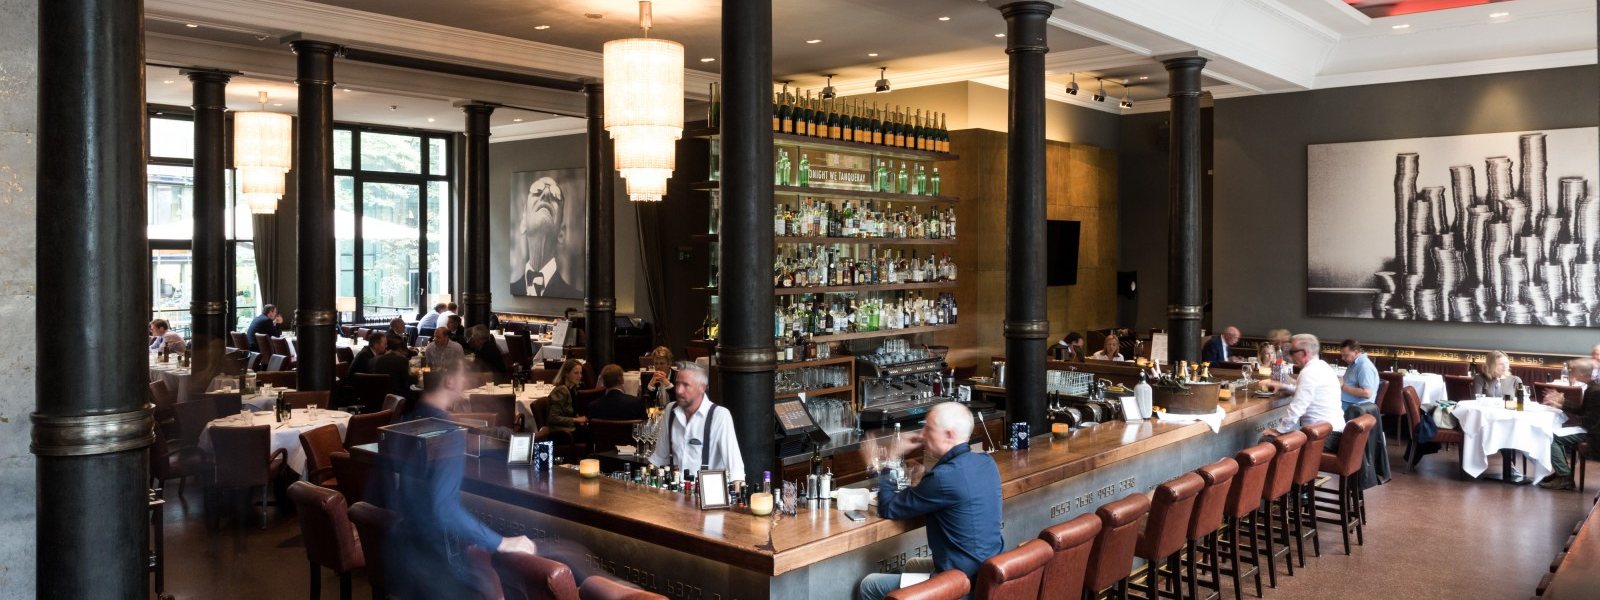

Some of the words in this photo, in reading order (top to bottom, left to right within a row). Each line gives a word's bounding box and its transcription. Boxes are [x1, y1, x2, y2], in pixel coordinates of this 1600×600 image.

[808, 169, 828, 180] ONIGHT
[830, 170, 837, 181] WE
[838, 171, 866, 182] TANQUERAY
[1520, 356, 1544, 366] 9565
[1050, 501, 1071, 519] 0553
[876, 552, 907, 573] 7638
